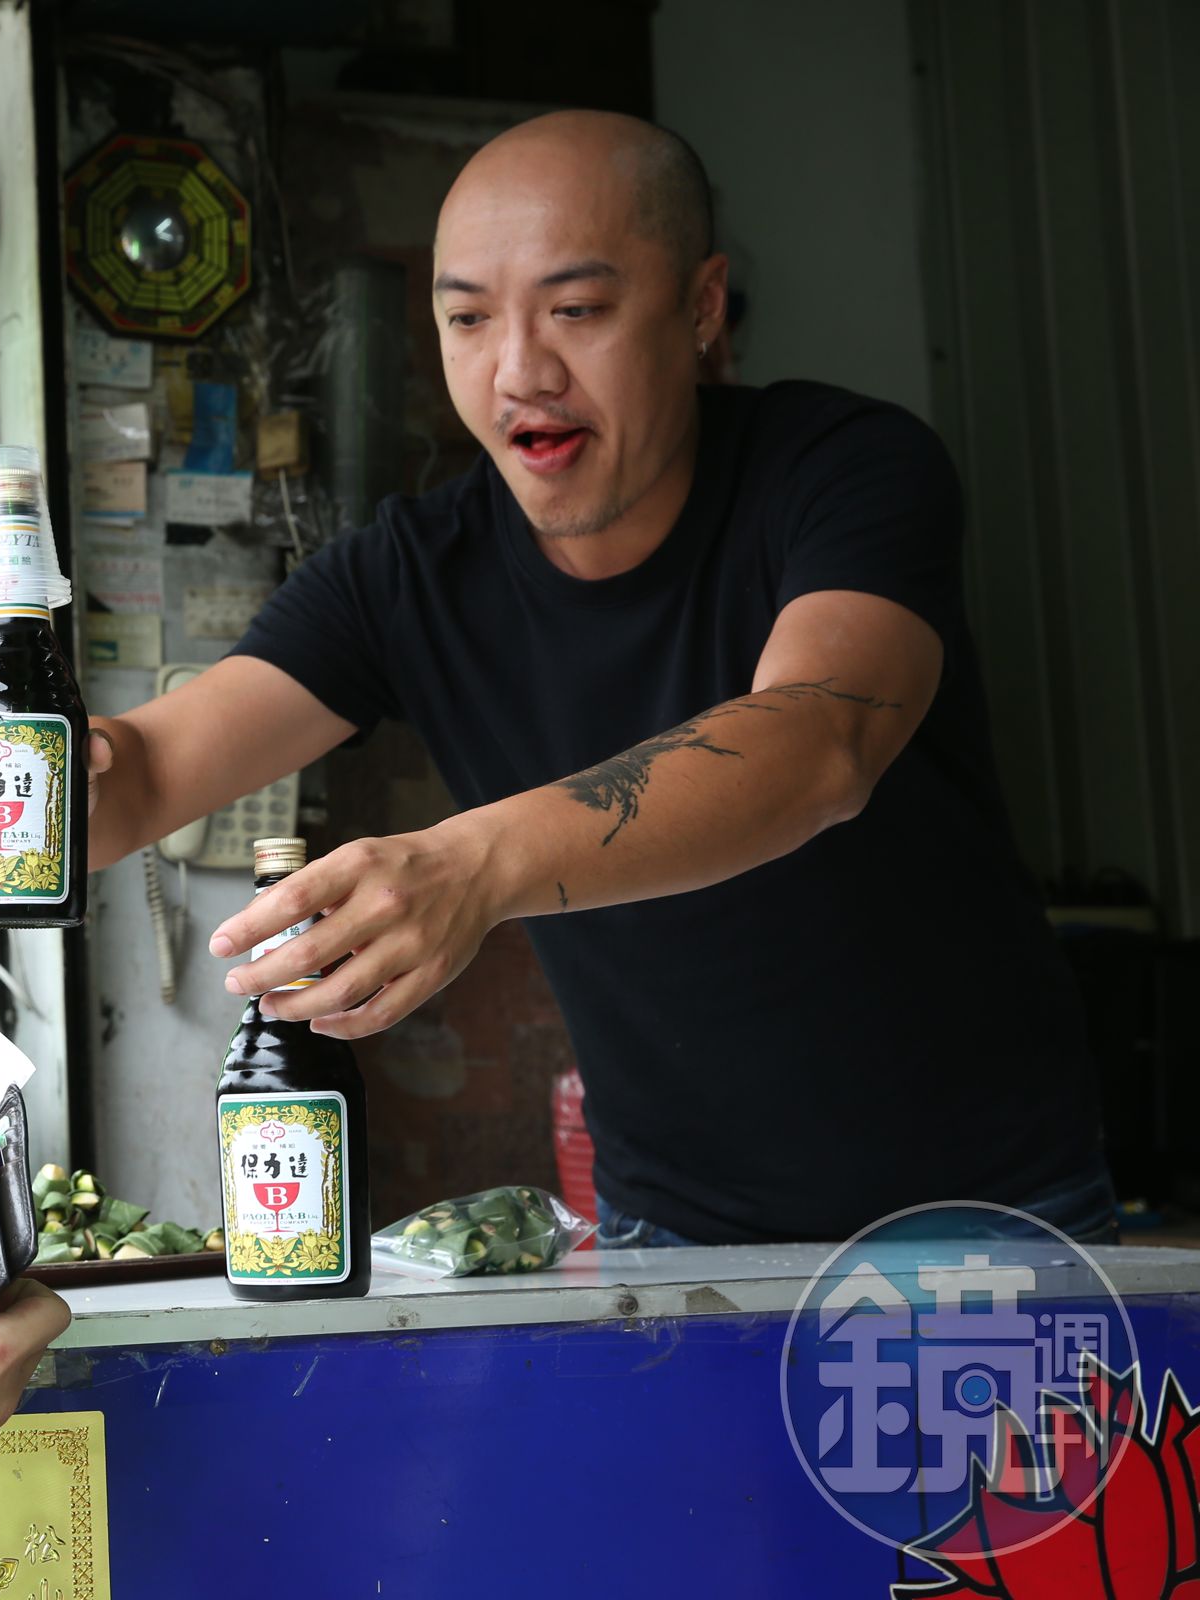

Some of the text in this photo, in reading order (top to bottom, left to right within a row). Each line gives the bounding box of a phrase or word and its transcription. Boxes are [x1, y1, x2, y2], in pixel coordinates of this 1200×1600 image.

[241, 1152, 309, 1179] 保力達
[264, 1186, 288, 1206] B
